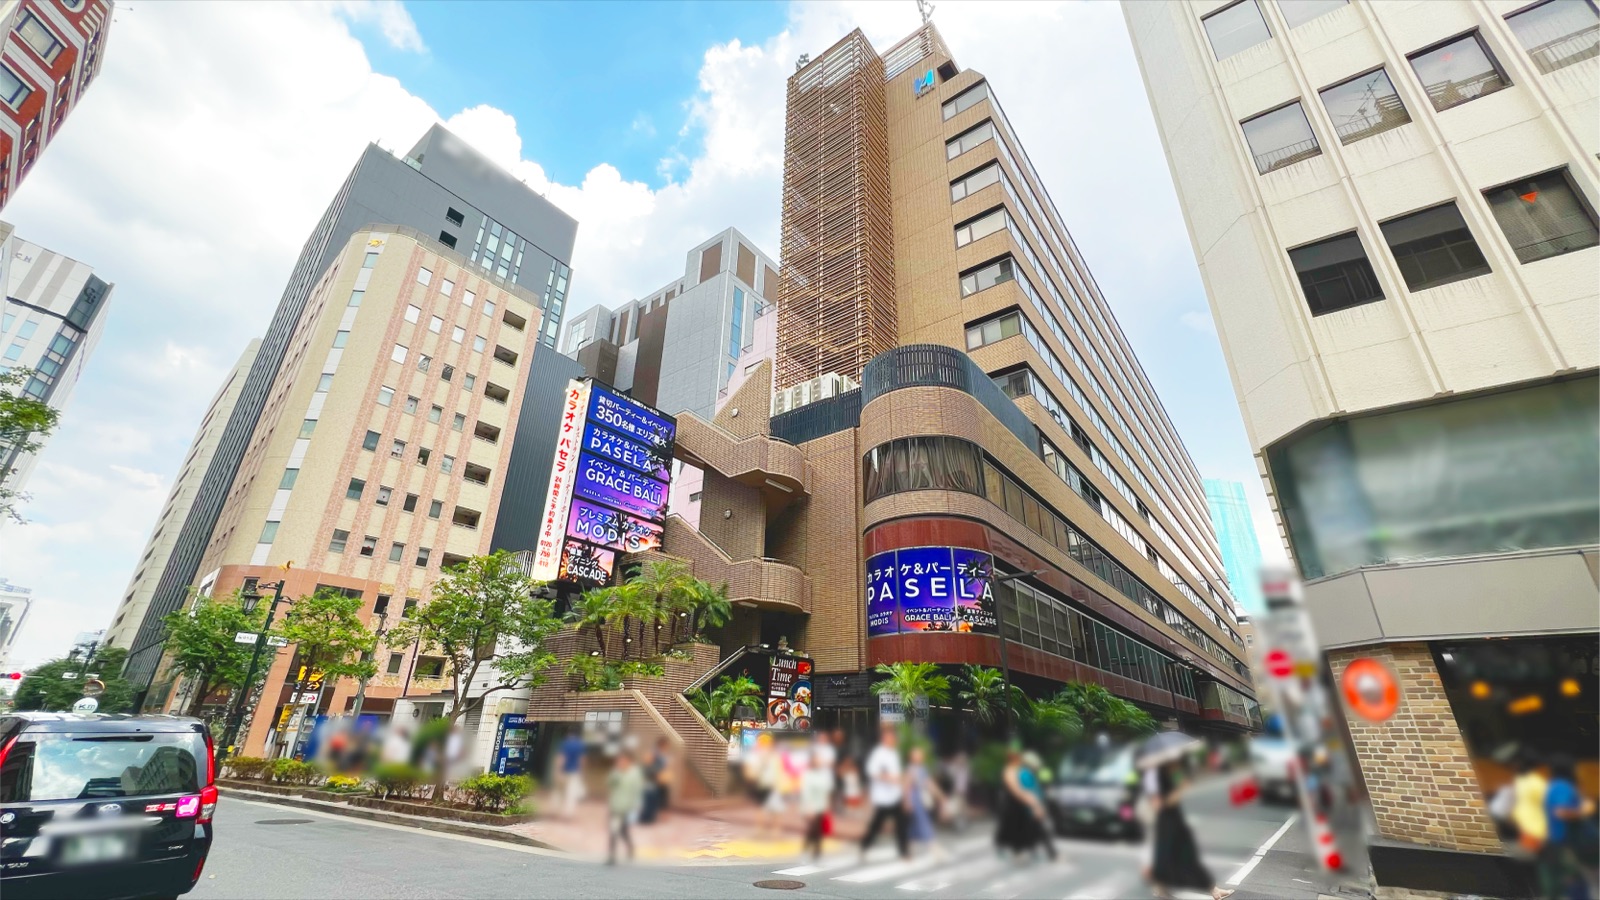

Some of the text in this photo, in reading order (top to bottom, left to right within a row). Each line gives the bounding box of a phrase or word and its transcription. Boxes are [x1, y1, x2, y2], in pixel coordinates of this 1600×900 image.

[563, 389, 580, 432] カラオケ
[590, 437, 652, 472] PASELA
[585, 468, 631, 495] GRACE
[633, 485, 661, 505] BALI
[576, 519, 641, 548] MODIS
[621, 521, 652, 536] カラオケ
[567, 563, 607, 581] CASCADE
[867, 562, 986, 585] カラオケ&パーティー
[867, 577, 994, 606] PASELA
[904, 614, 931, 622] GRACE
[963, 614, 997, 626] CASCADE
[772, 655, 797, 670] Lunch
[771, 667, 793, 683] Time
